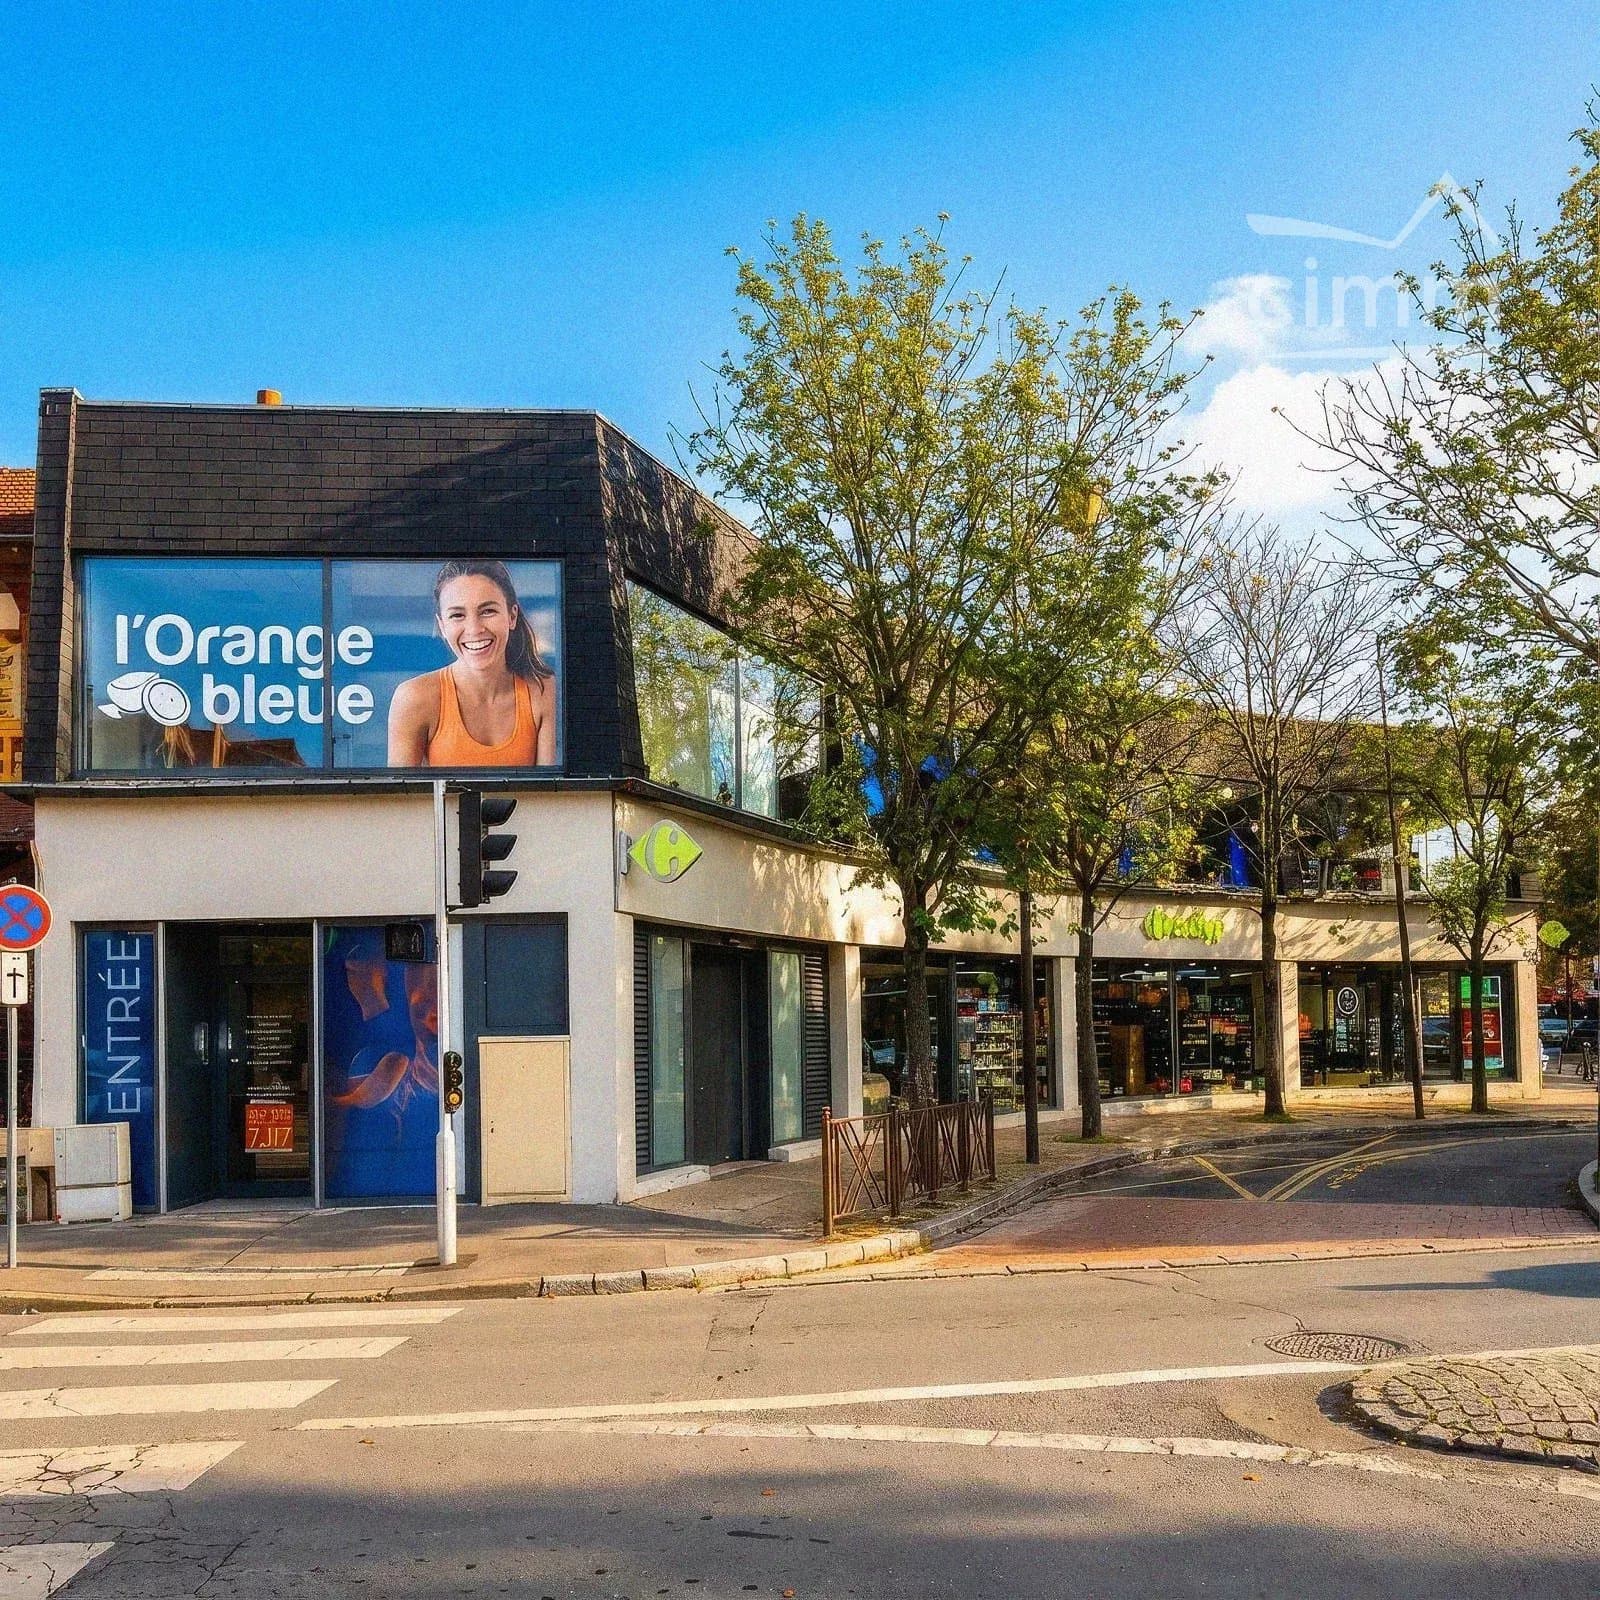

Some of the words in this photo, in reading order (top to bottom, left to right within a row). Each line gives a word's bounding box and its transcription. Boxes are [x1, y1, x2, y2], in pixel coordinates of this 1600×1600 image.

[116, 613, 374, 680] l'Orange
[202, 673, 375, 724] bleue
[98, 938, 141, 1113] ENTRÉE
